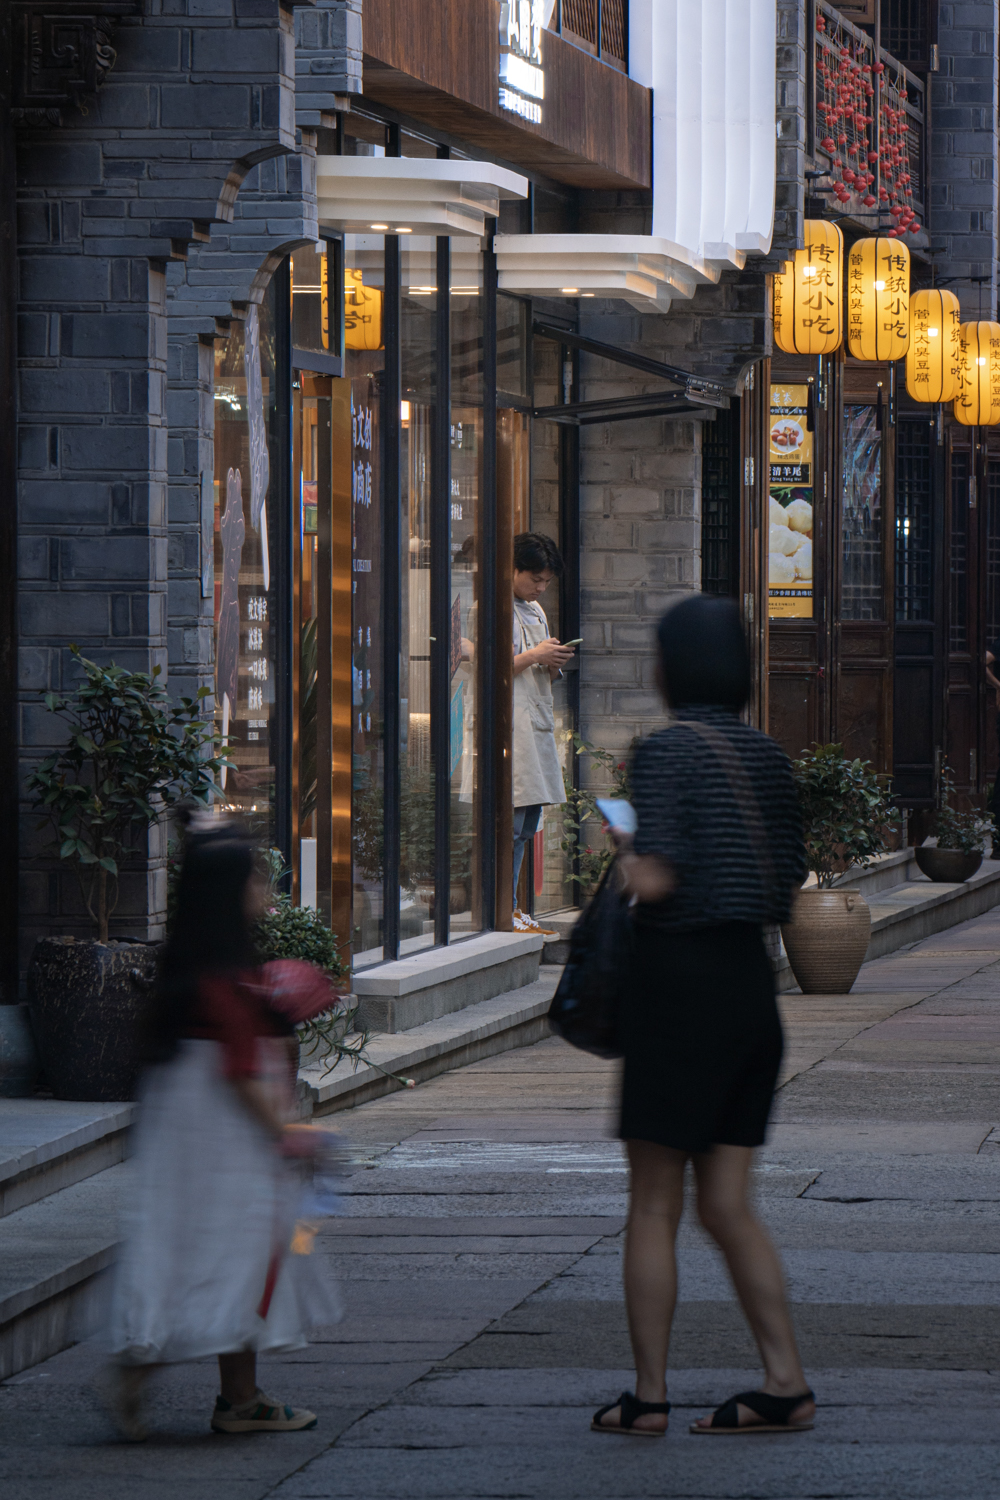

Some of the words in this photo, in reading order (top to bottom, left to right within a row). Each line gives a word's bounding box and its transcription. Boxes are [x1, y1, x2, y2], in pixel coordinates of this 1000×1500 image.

[801, 243, 835, 335] 传统小吃
[881, 254, 908, 339] 传统小吃
[769, 466, 802, 477] 清羊尾
